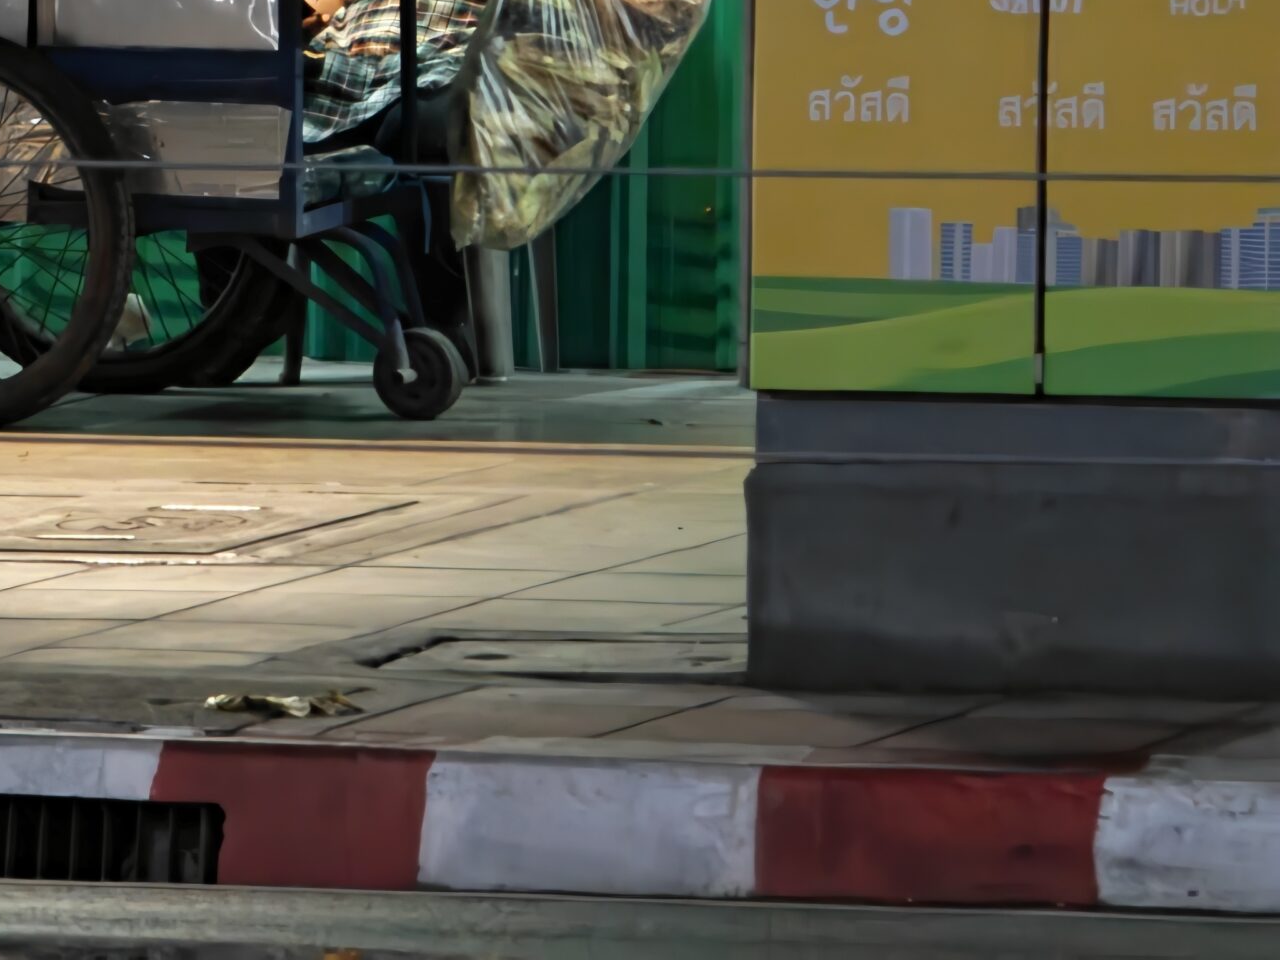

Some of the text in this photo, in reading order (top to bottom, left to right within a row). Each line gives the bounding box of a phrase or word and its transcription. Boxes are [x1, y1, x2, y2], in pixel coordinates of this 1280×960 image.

[808, 74, 910, 123] สวัสดี
[1152, 84, 1258, 131] สวัสดี
